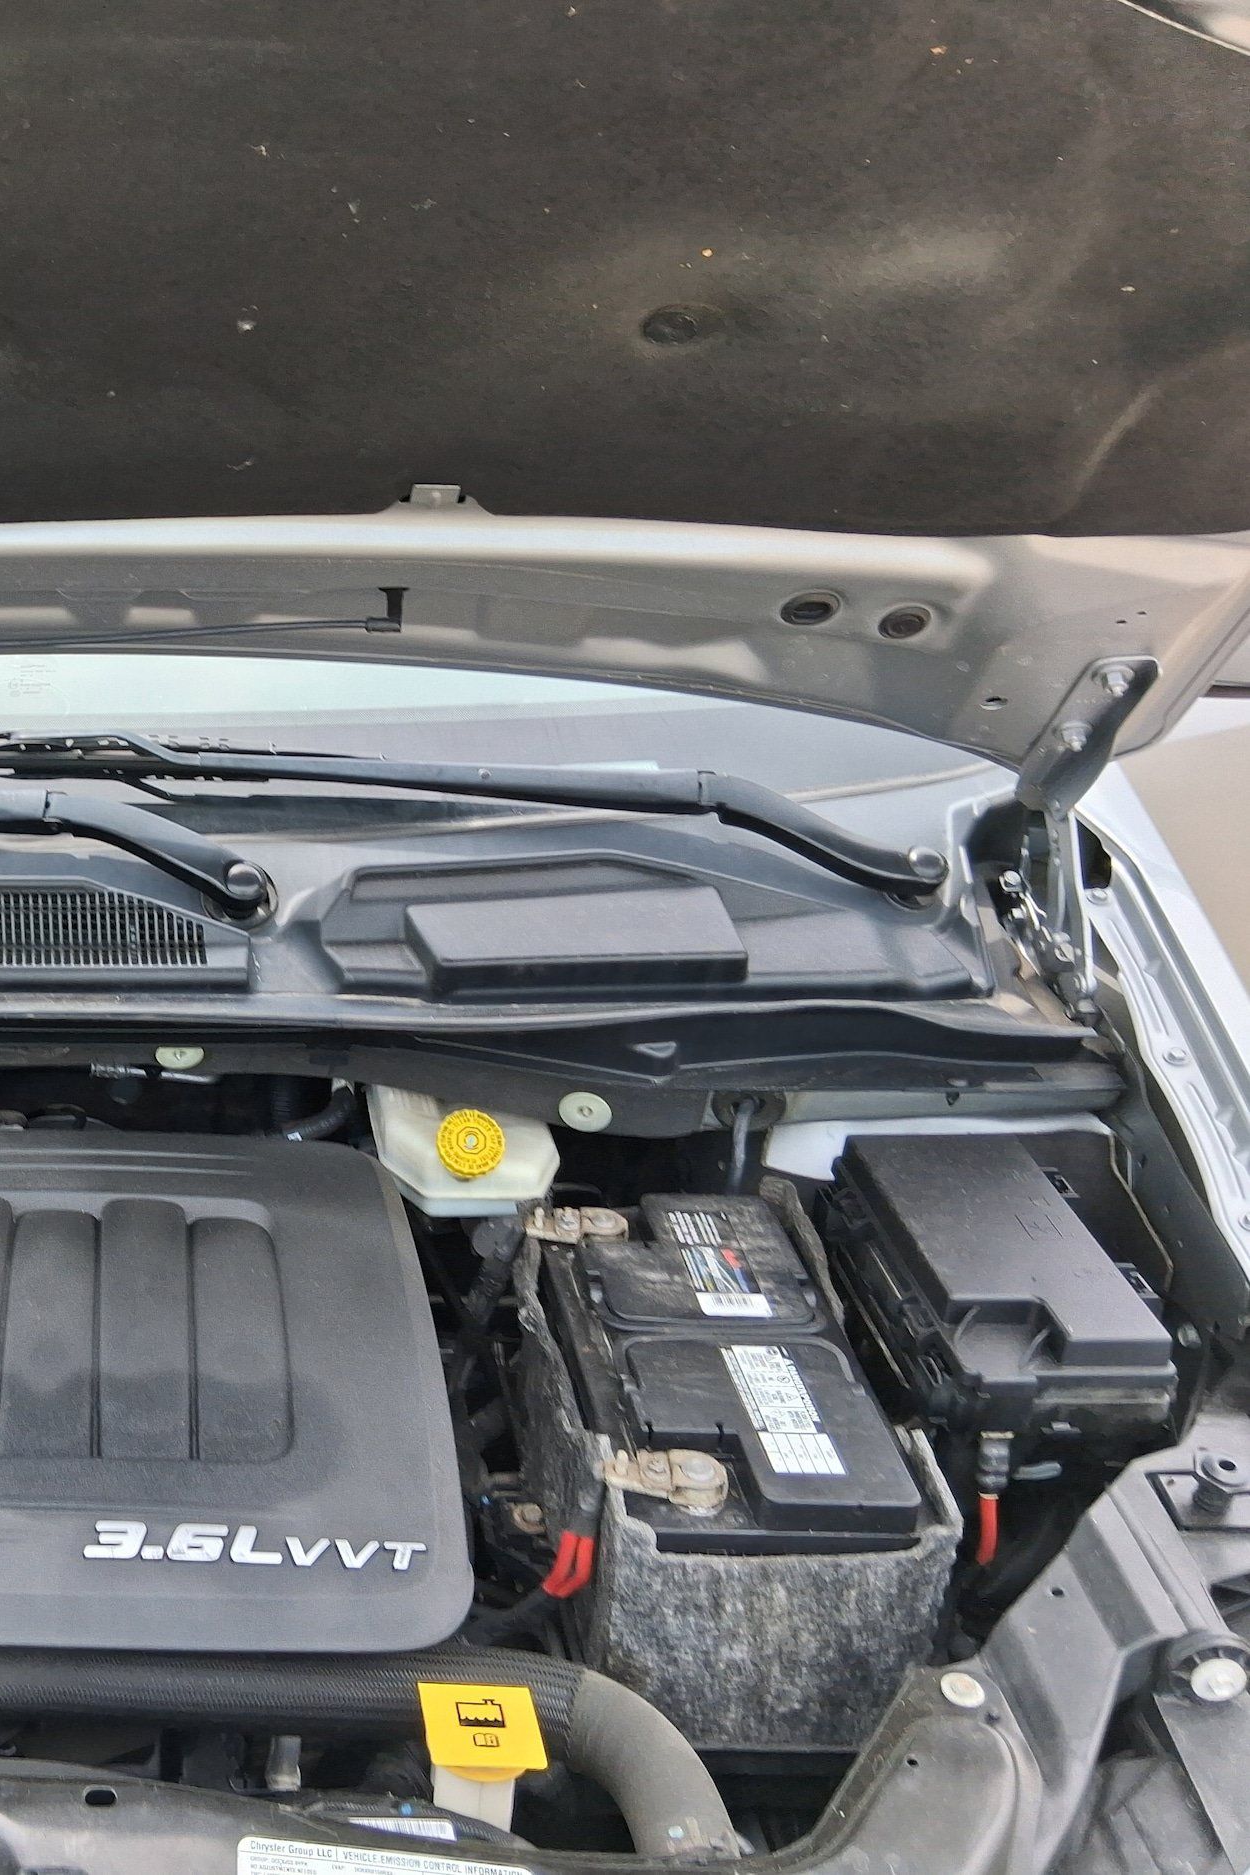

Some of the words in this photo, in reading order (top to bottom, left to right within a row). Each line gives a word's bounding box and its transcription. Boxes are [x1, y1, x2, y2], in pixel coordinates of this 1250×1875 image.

[250, 1840, 285, 1853] Chrysler
[288, 1844, 314, 1857] Group
[316, 1847, 333, 1858] LLC
[342, 1850, 378, 1863] VEHICLE
[380, 1855, 421, 1869] EMISSION
[423, 1860, 462, 1873] CONTROL
